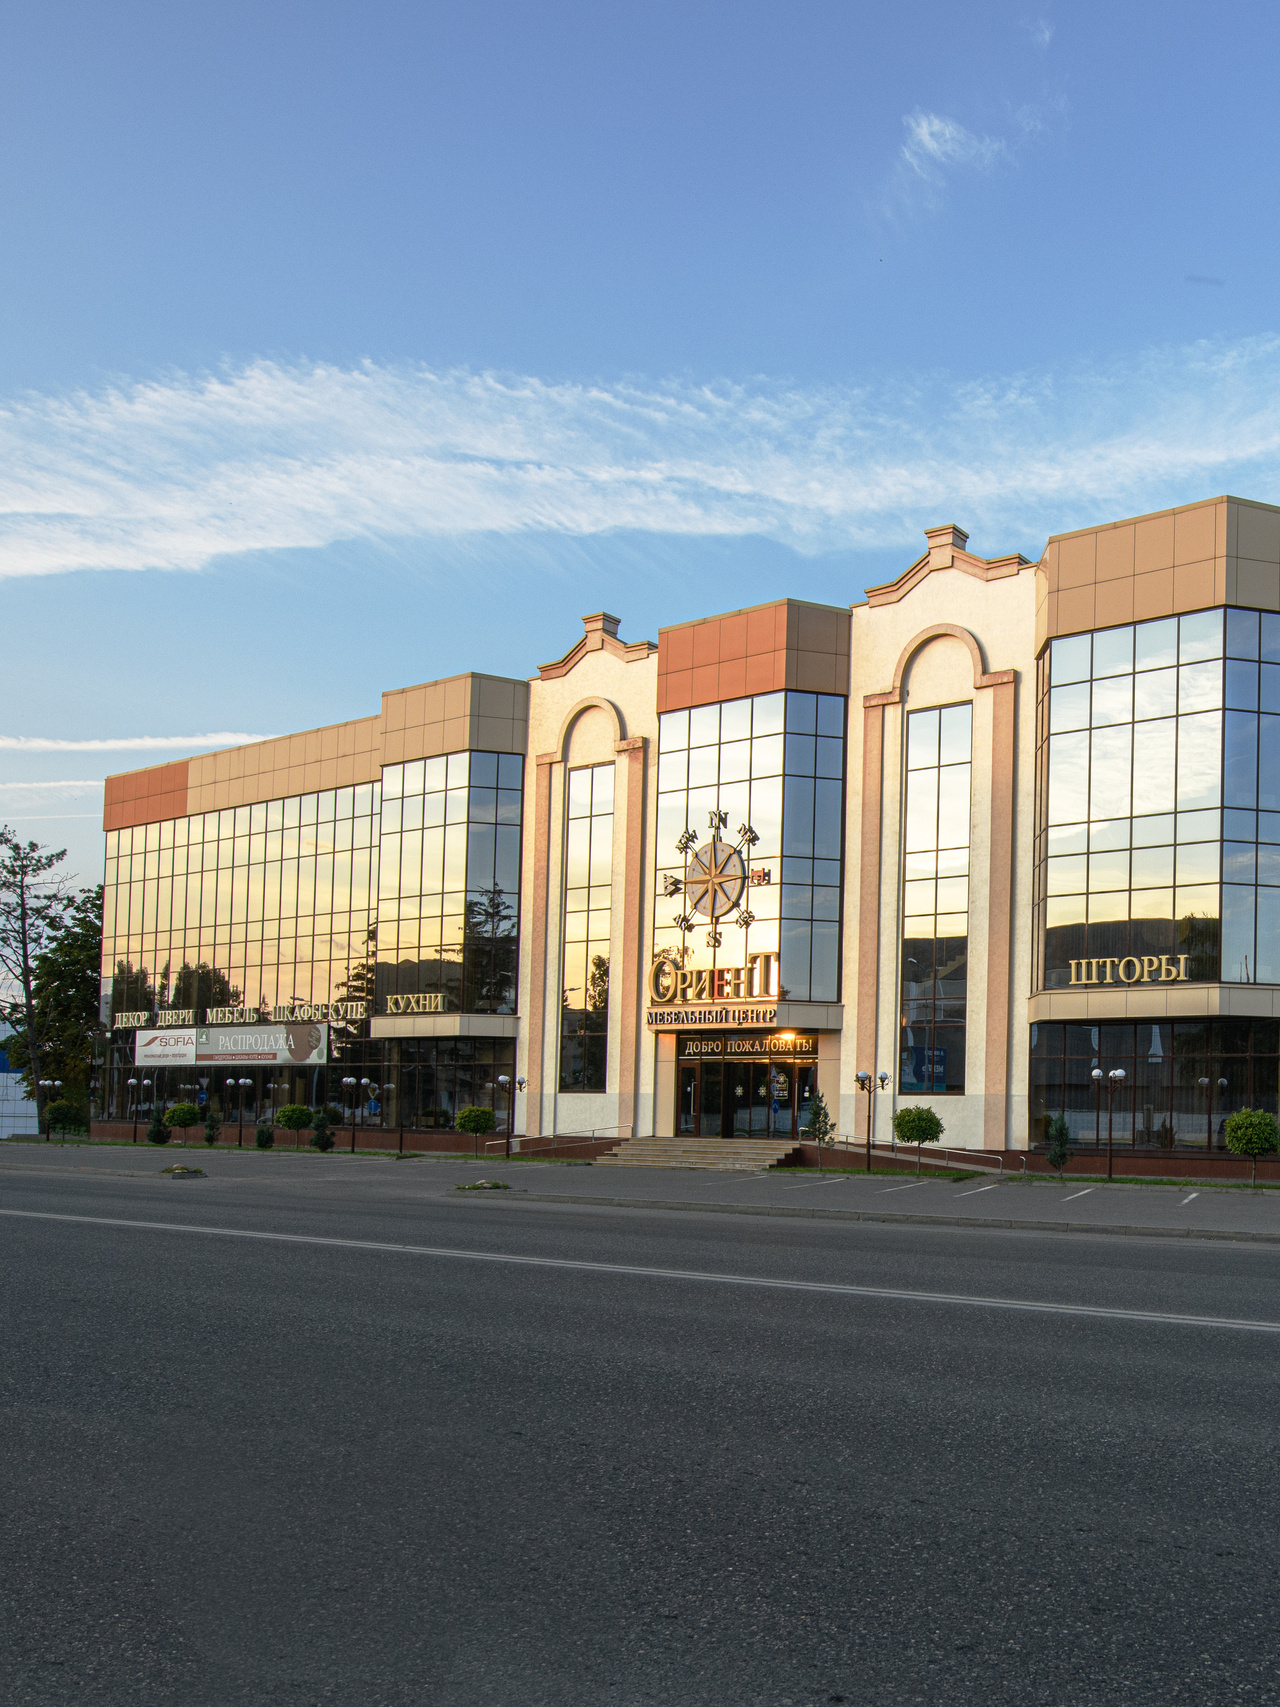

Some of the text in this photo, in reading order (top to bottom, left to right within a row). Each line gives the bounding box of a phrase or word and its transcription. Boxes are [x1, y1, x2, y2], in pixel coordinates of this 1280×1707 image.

[708, 810, 725, 829] N
[706, 931, 720, 948] S
[1069, 954, 1190, 985] ШТОРЫ
[271, 1001, 367, 1022] ШКАФЫ-КУПЕ
[386, 993, 444, 1013] КУХНИ
[113, 1011, 149, 1031] ДЕКОР
[156, 1009, 194, 1028] ДВЕРИ
[206, 1007, 256, 1024] МЕБЕЛЬ
[646, 1007, 776, 1026] МЕБЕЛЬНЫЙ ЦЕНТР
[159, 1035, 195, 1047] SOFIA
[218, 1033, 295, 1051] РАСПРОДАЖА
[686, 1040, 812, 1054] ДОБРО ПОЖАЛОВАТЬ!
